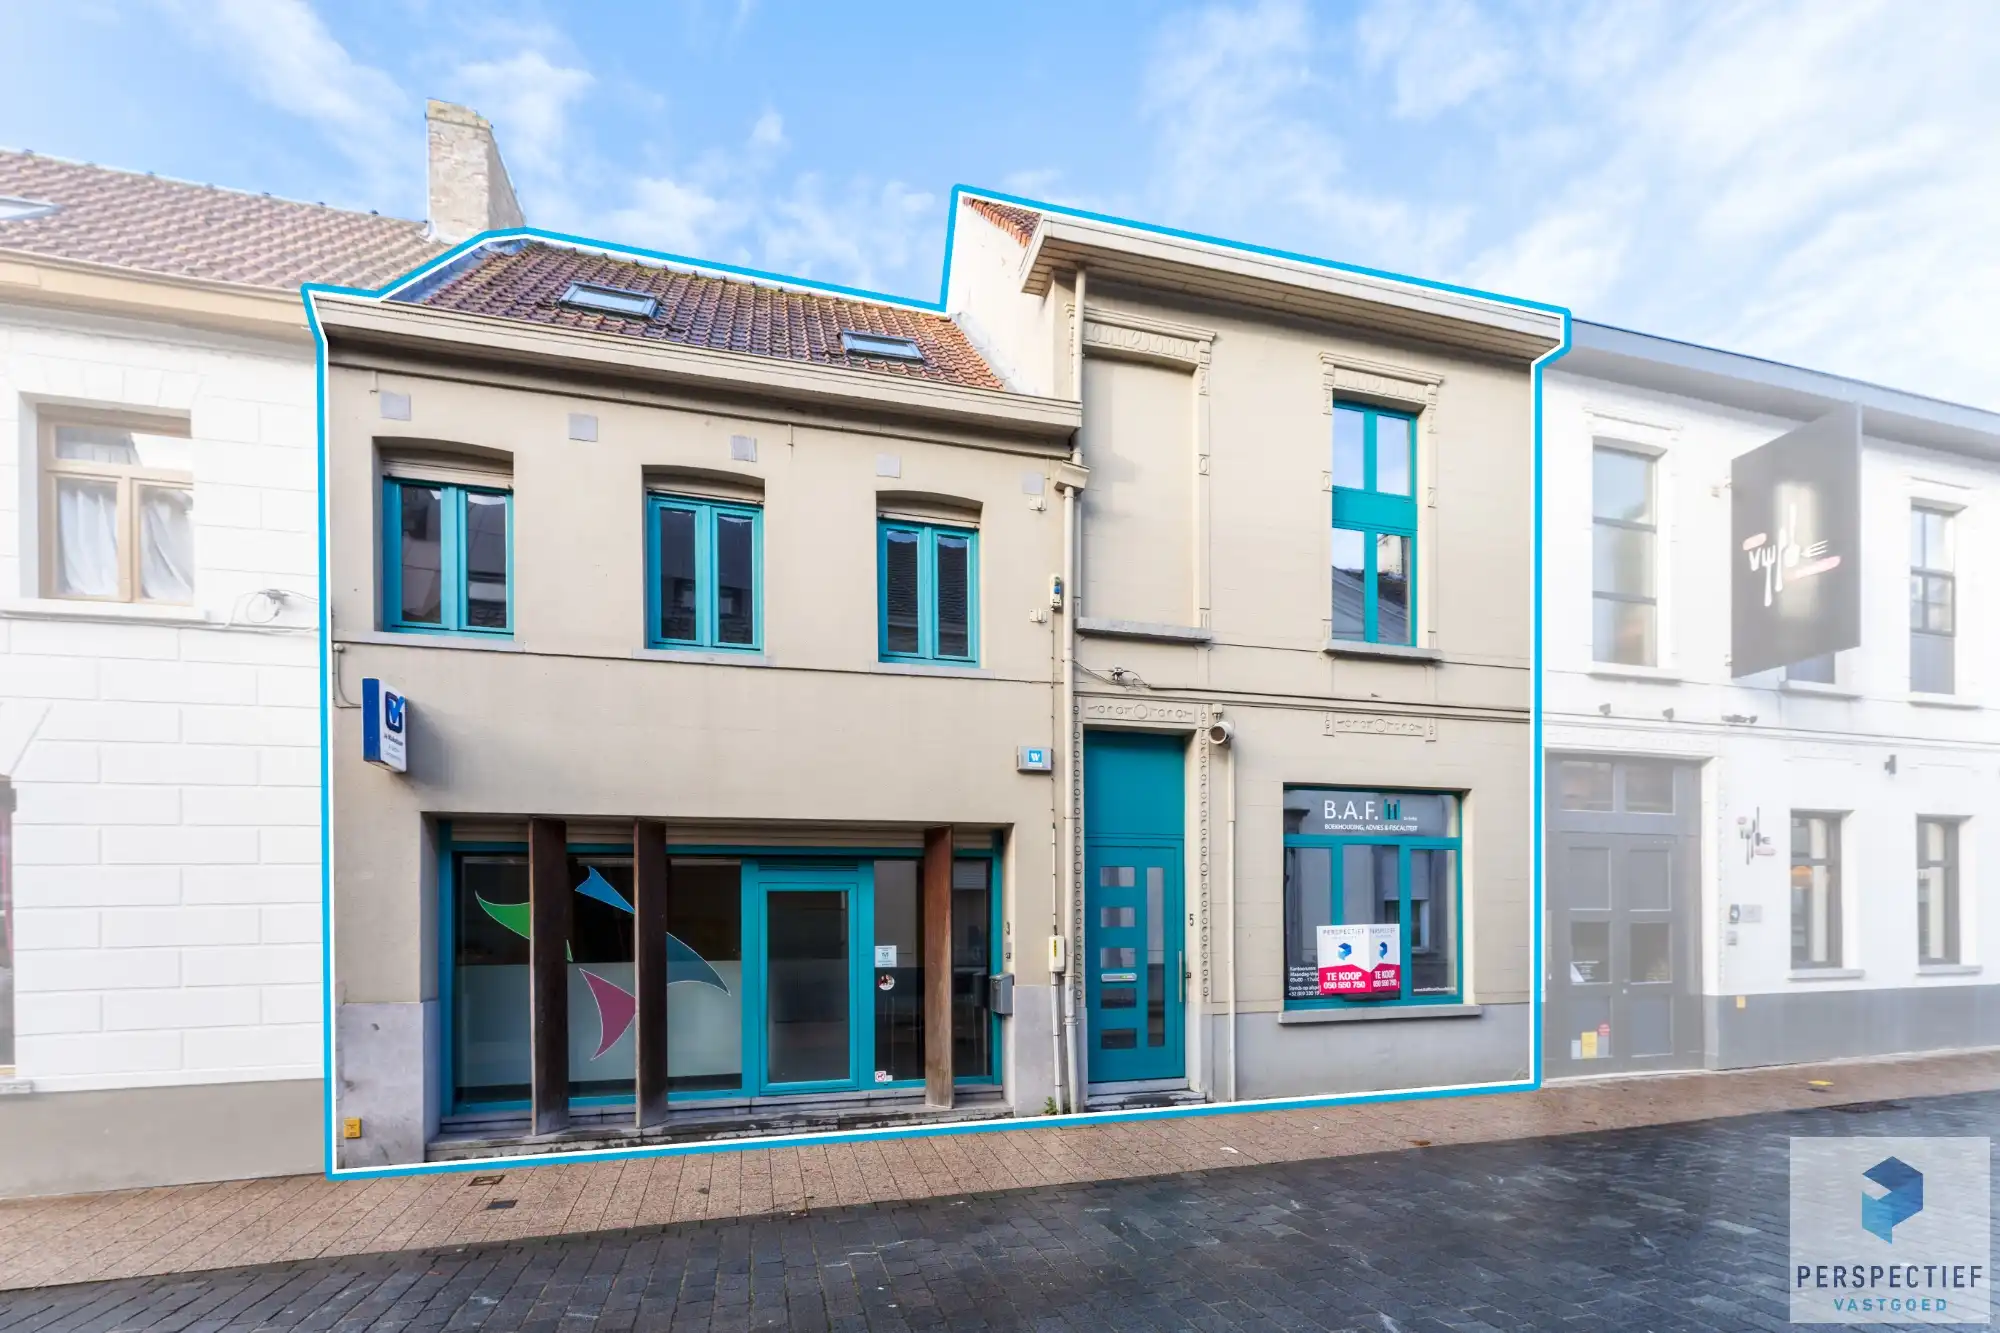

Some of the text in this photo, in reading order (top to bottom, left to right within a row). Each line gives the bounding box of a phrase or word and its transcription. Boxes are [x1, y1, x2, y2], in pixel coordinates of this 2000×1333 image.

[1324, 800, 1379, 820] B.A.F.
[1189, 913, 1195, 927] 5
[1326, 971, 1362, 981] TE KOOP
[1374, 970, 1395, 979] TE KOOP
